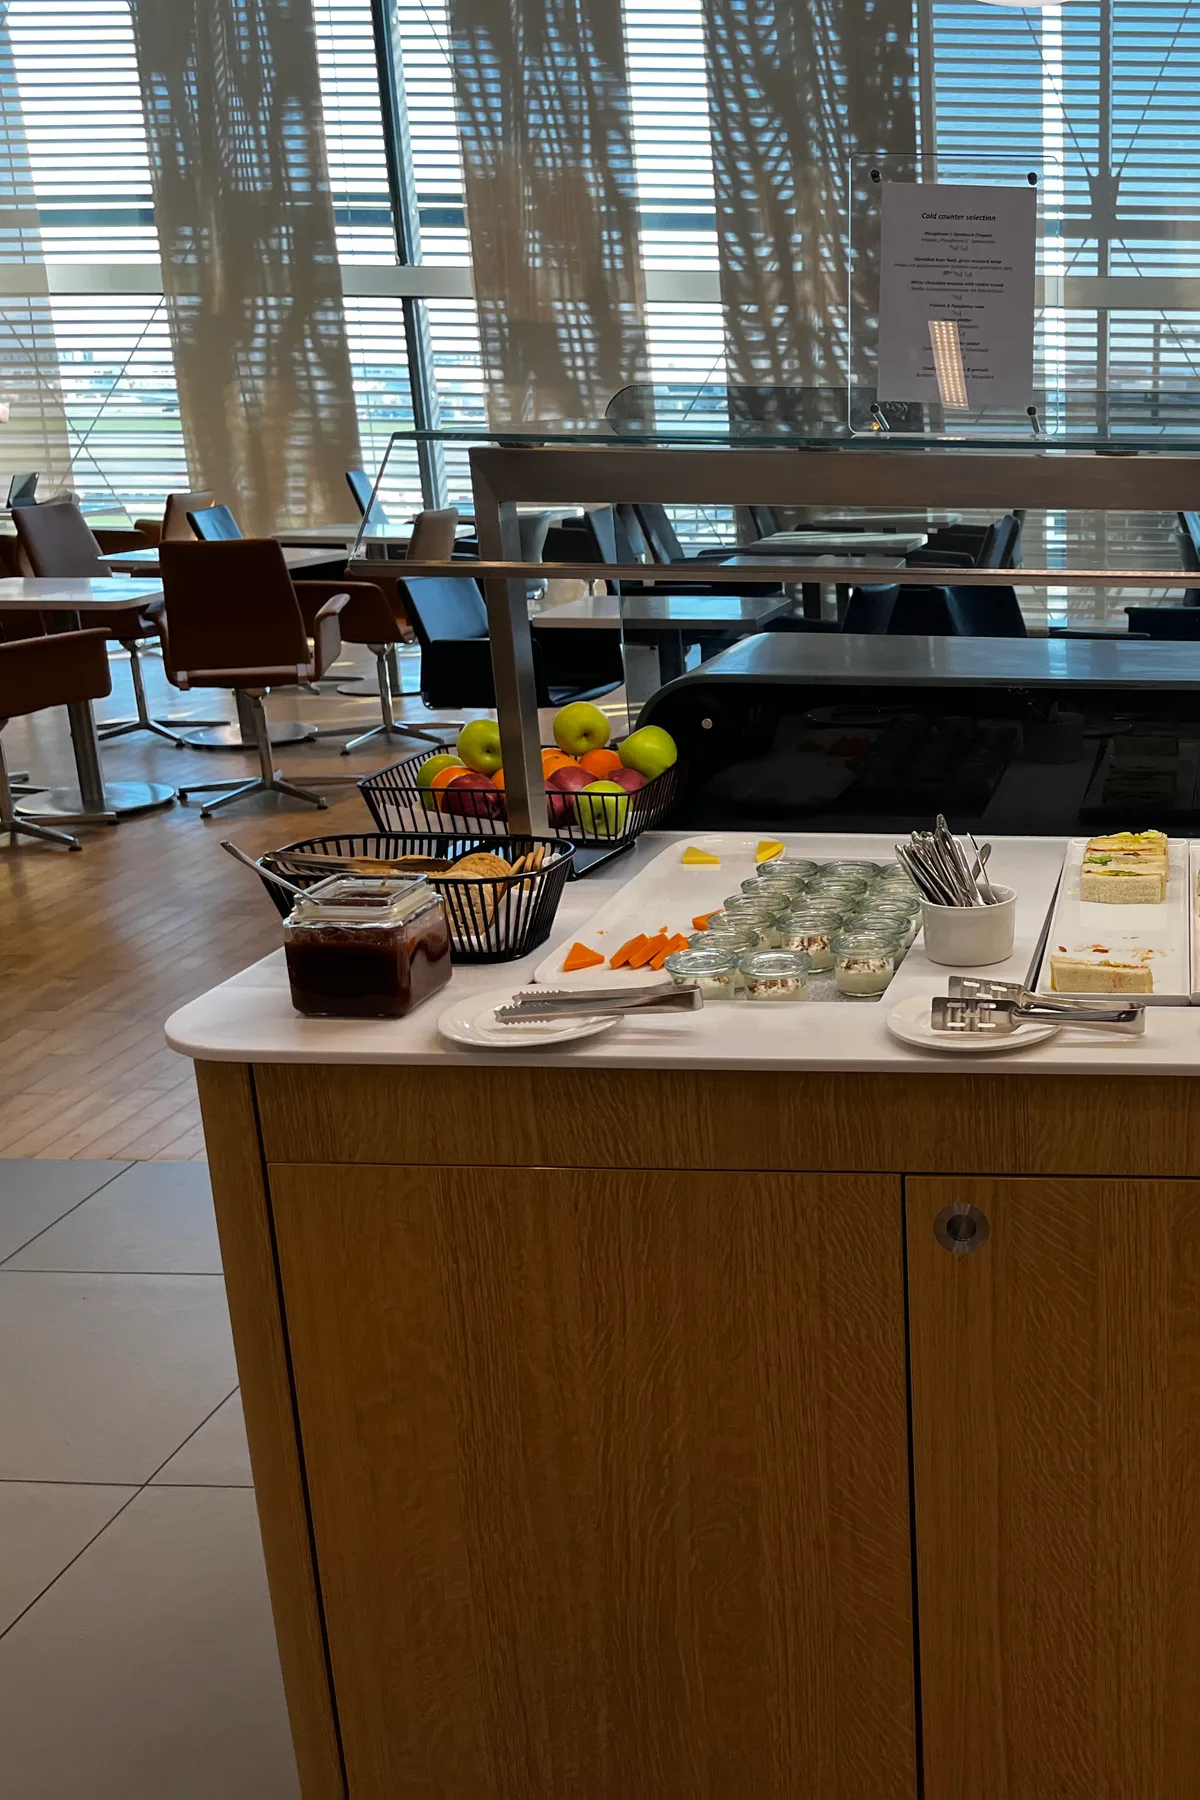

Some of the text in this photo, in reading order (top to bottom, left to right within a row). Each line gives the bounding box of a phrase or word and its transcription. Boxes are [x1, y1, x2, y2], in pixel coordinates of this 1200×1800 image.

[921, 212, 996, 222] Cold counter selection
